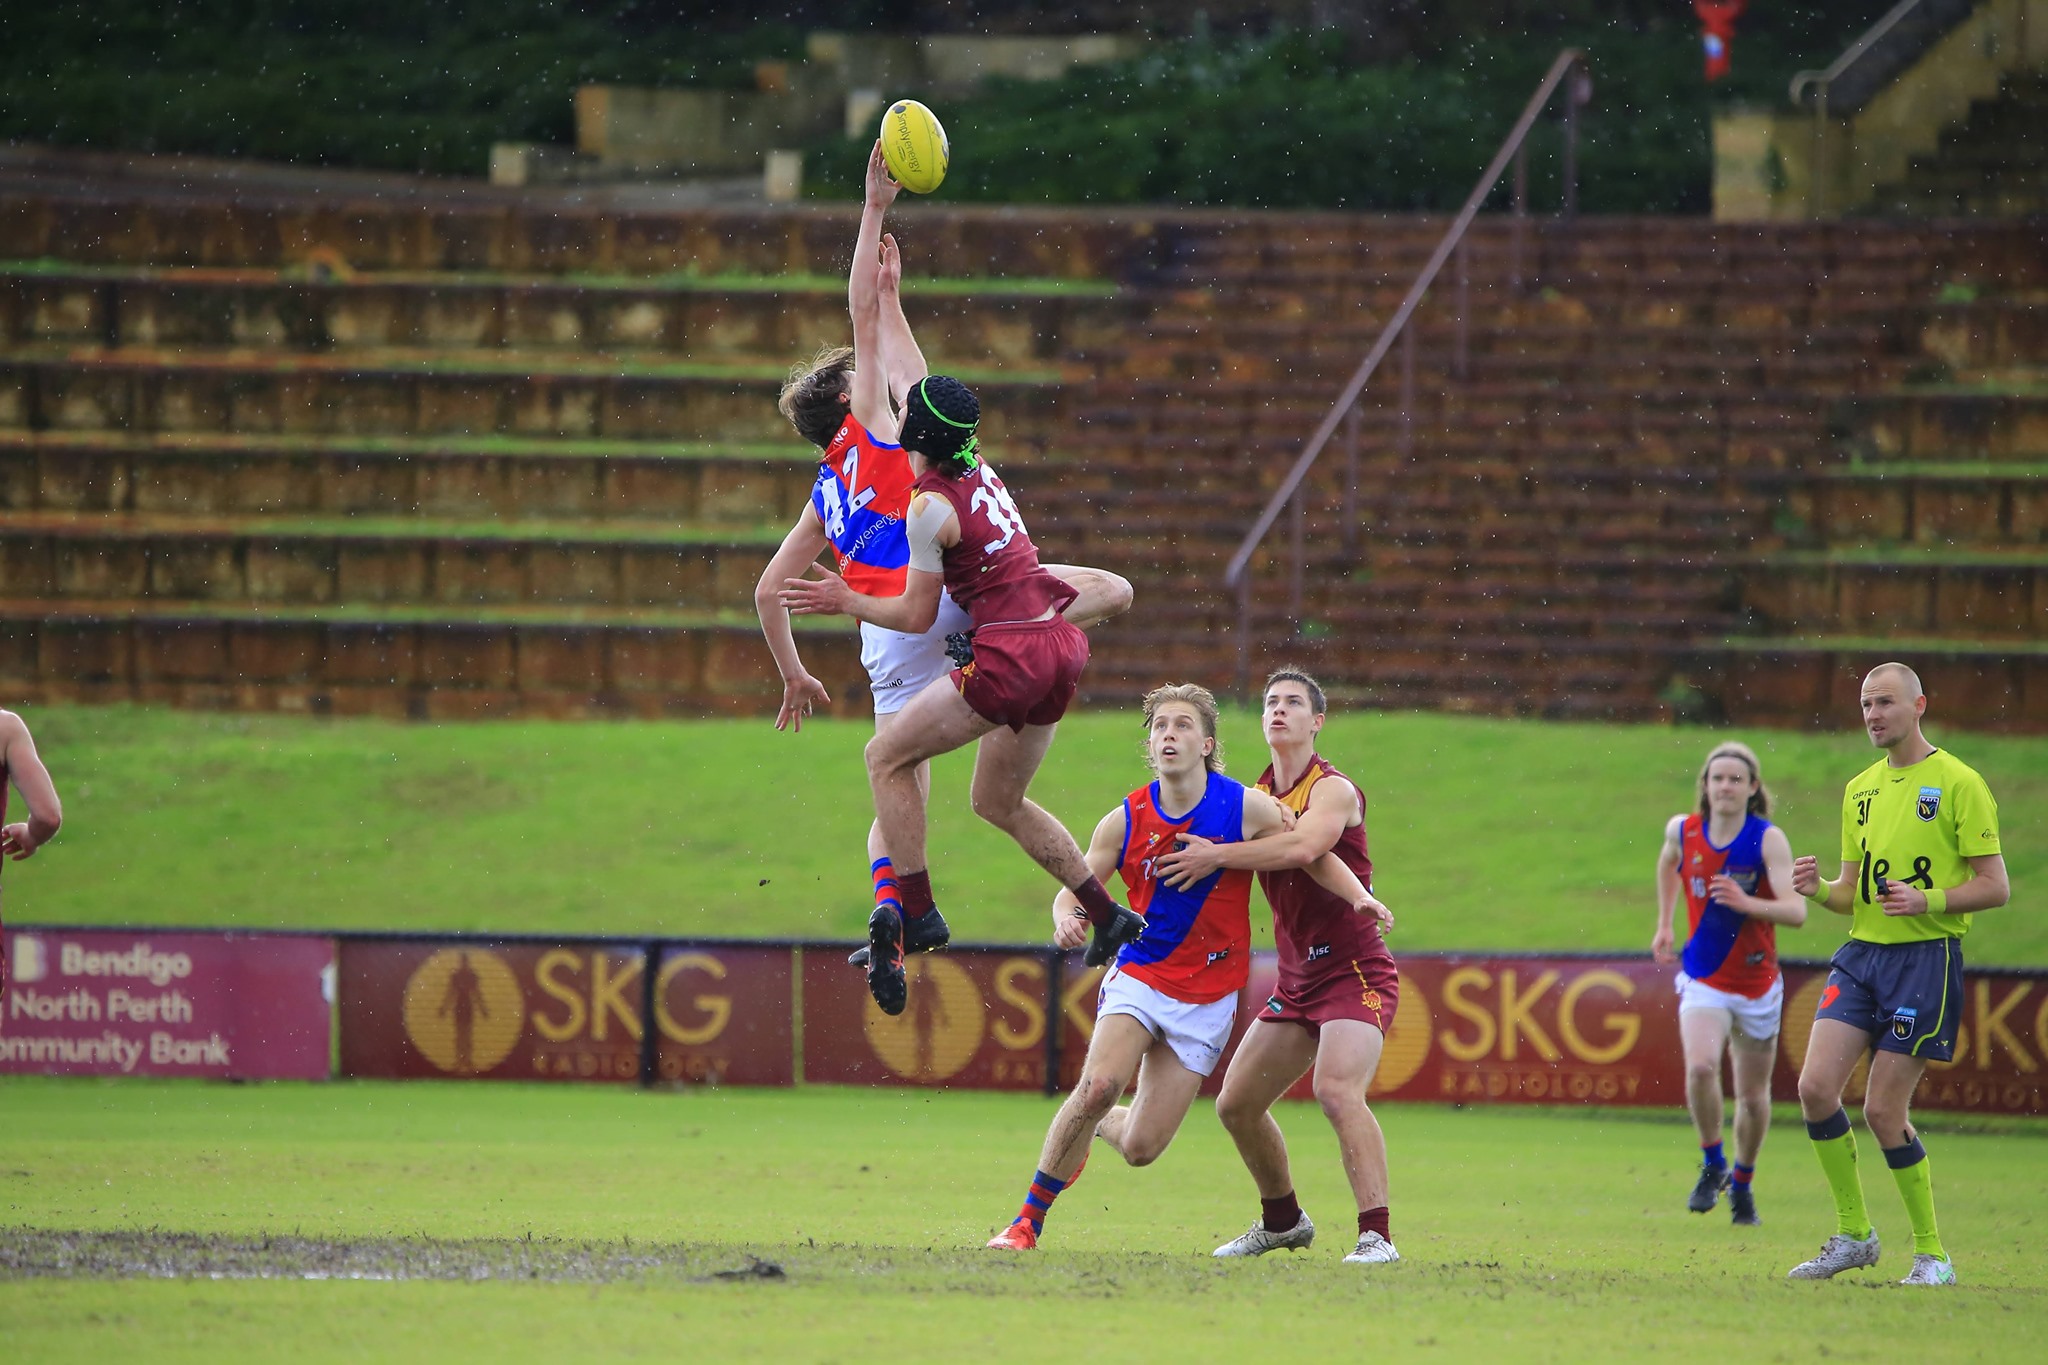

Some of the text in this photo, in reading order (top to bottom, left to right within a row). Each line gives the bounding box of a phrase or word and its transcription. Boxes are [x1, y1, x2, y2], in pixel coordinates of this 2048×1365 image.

[821, 444, 877, 539] 42
[1852, 788, 1880, 800] OPTUS
[1857, 798, 1872, 826] 31
[61, 942, 192, 986] Bendigo
[1315, 945, 1330, 956] ISC
[11, 988, 193, 1023] North Perth
[531, 949, 731, 1045] SKG
[1439, 966, 1642, 1064] SKG
[150, 1031, 230, 1065] Bank
[532, 1051, 730, 1079] RADIOOGY
[1440, 1070, 1642, 1098] RADIOLOGY
